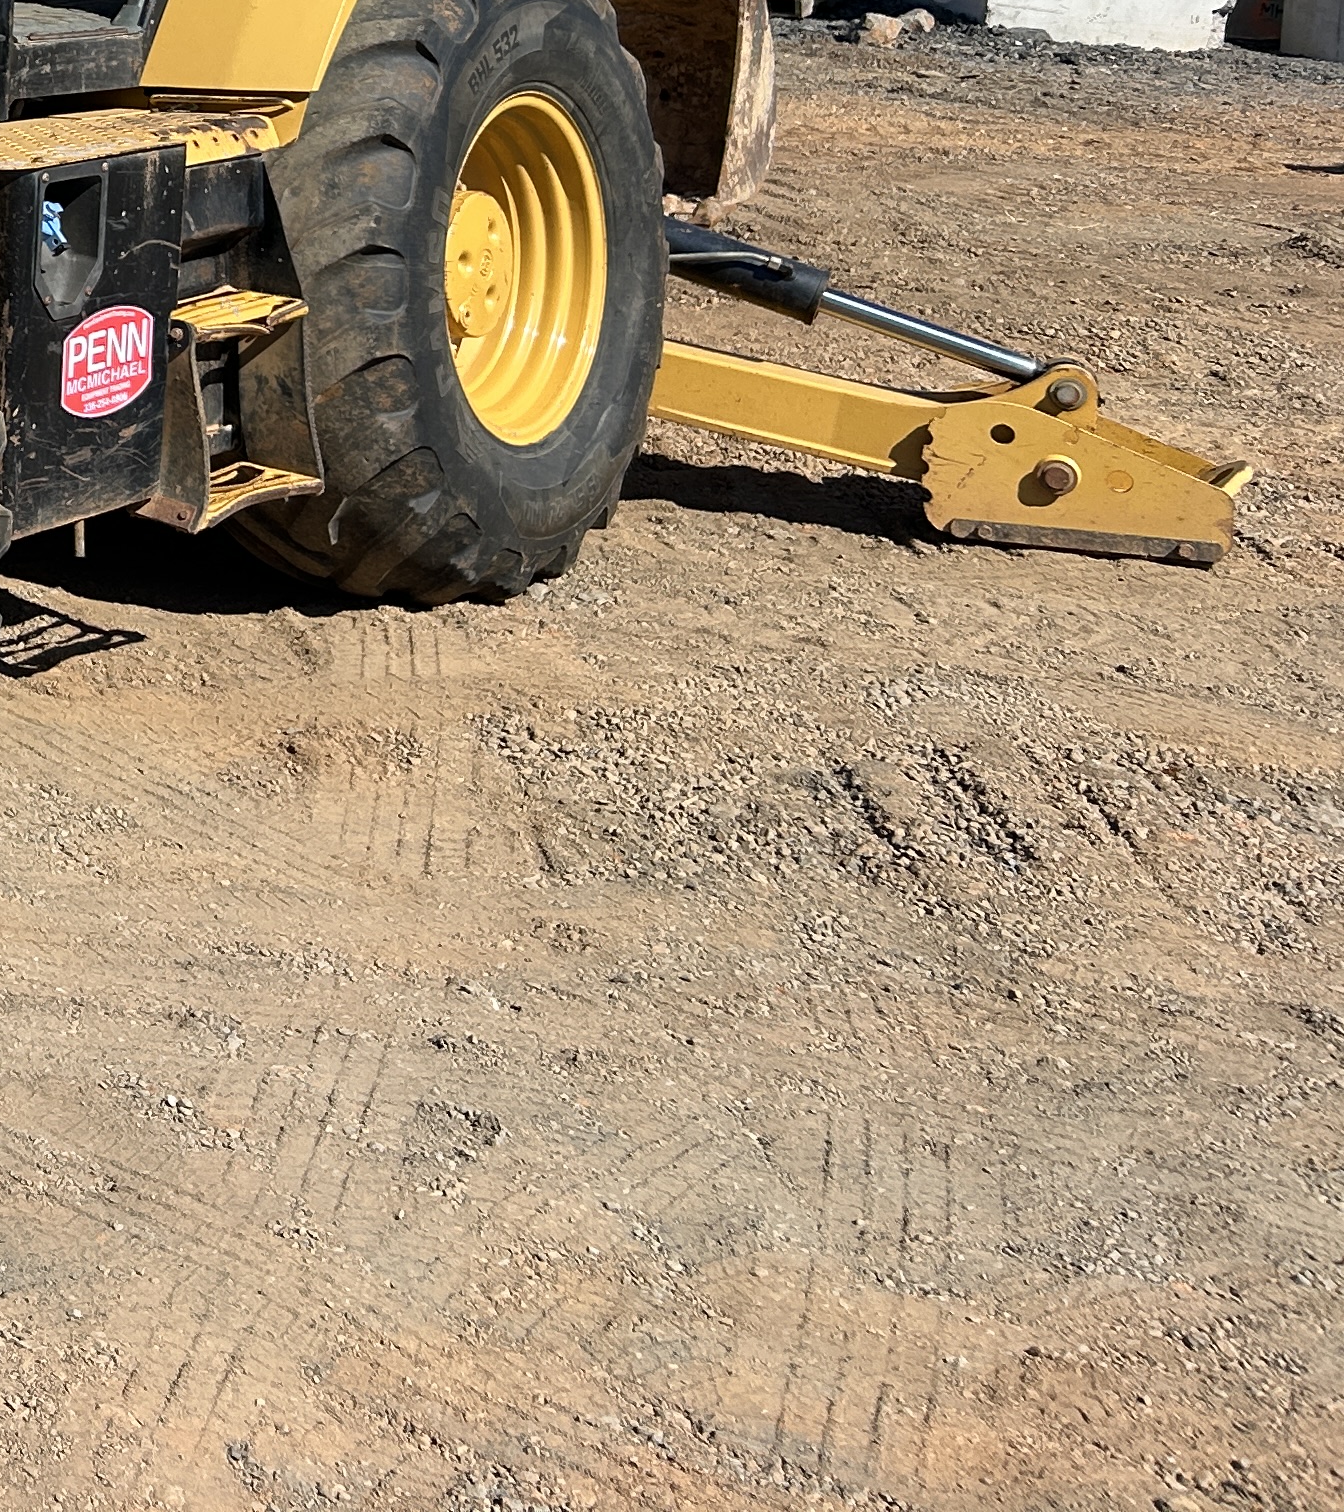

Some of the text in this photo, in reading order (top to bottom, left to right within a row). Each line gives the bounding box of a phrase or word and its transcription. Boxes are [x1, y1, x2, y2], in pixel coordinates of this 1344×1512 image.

[467, 24, 520, 96] BHL 532
[66, 359, 147, 396] MCMICHAEL
[67, 317, 149, 378] PENN
